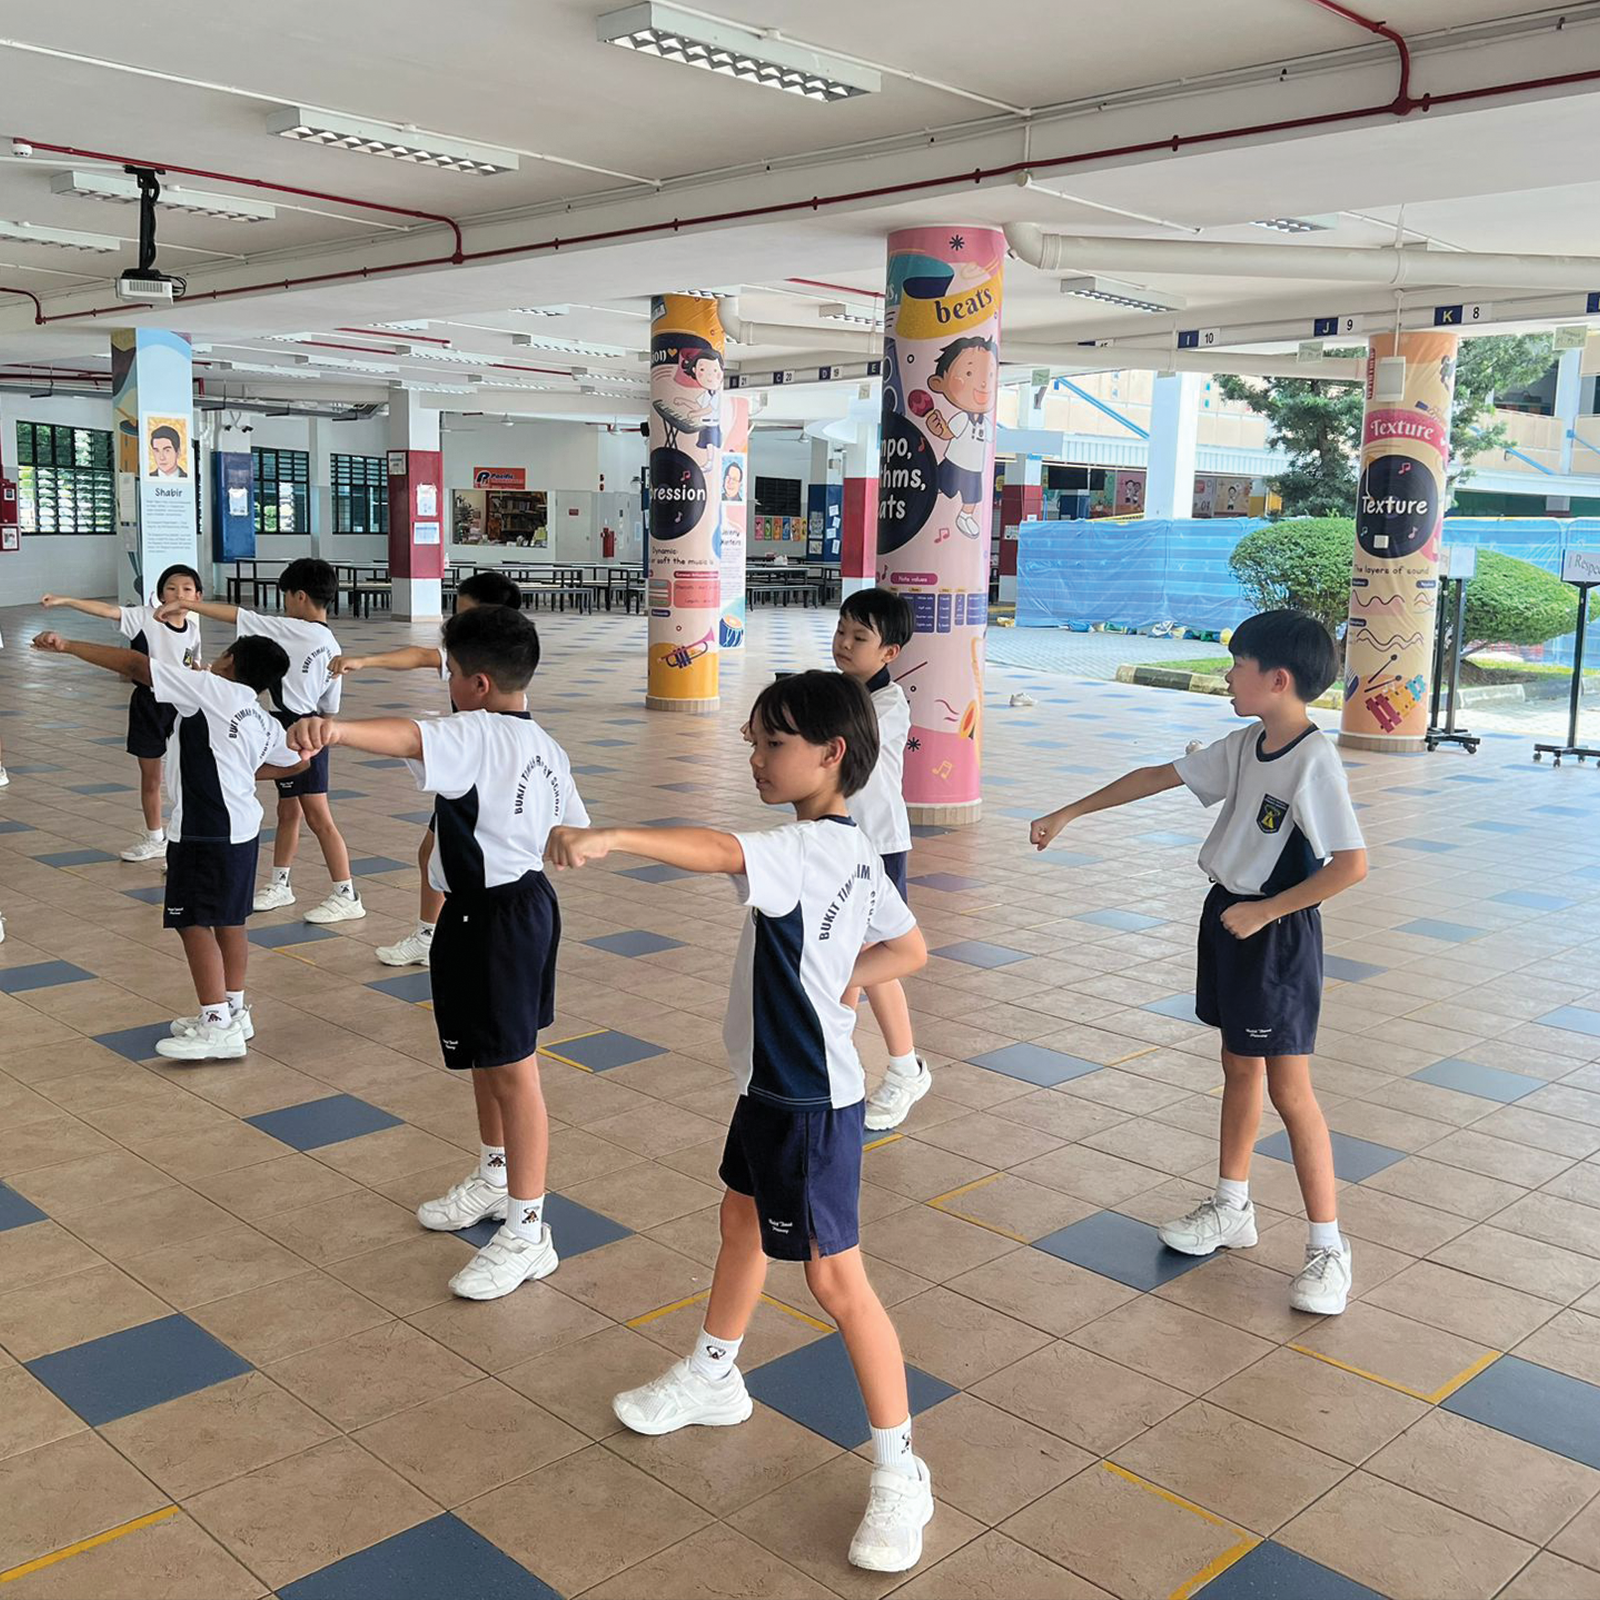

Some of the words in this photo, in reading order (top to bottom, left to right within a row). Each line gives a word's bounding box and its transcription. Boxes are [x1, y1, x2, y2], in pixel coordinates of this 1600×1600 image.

[935, 288, 992, 324] beats
[1443, 310, 1453, 323] K
[1472, 306, 1480, 320] 8
[1322, 321, 1330, 334] J
[1346, 318, 1354, 331] 9
[1205, 332, 1214, 344] 10
[822, 371, 827, 379] D
[871, 364, 876, 373] E
[785, 372, 792, 382] 20
[1370, 419, 1434, 439] Texture
[155, 488, 183, 498] Shabir
[652, 484, 706, 501] ression
[1361, 496, 1428, 515] Texture
[673, 557, 685, 565] the
[1364, 565, 1389, 575] layers
[1392, 565, 1404, 574] of
[819, 901, 840, 941] BUKIT
